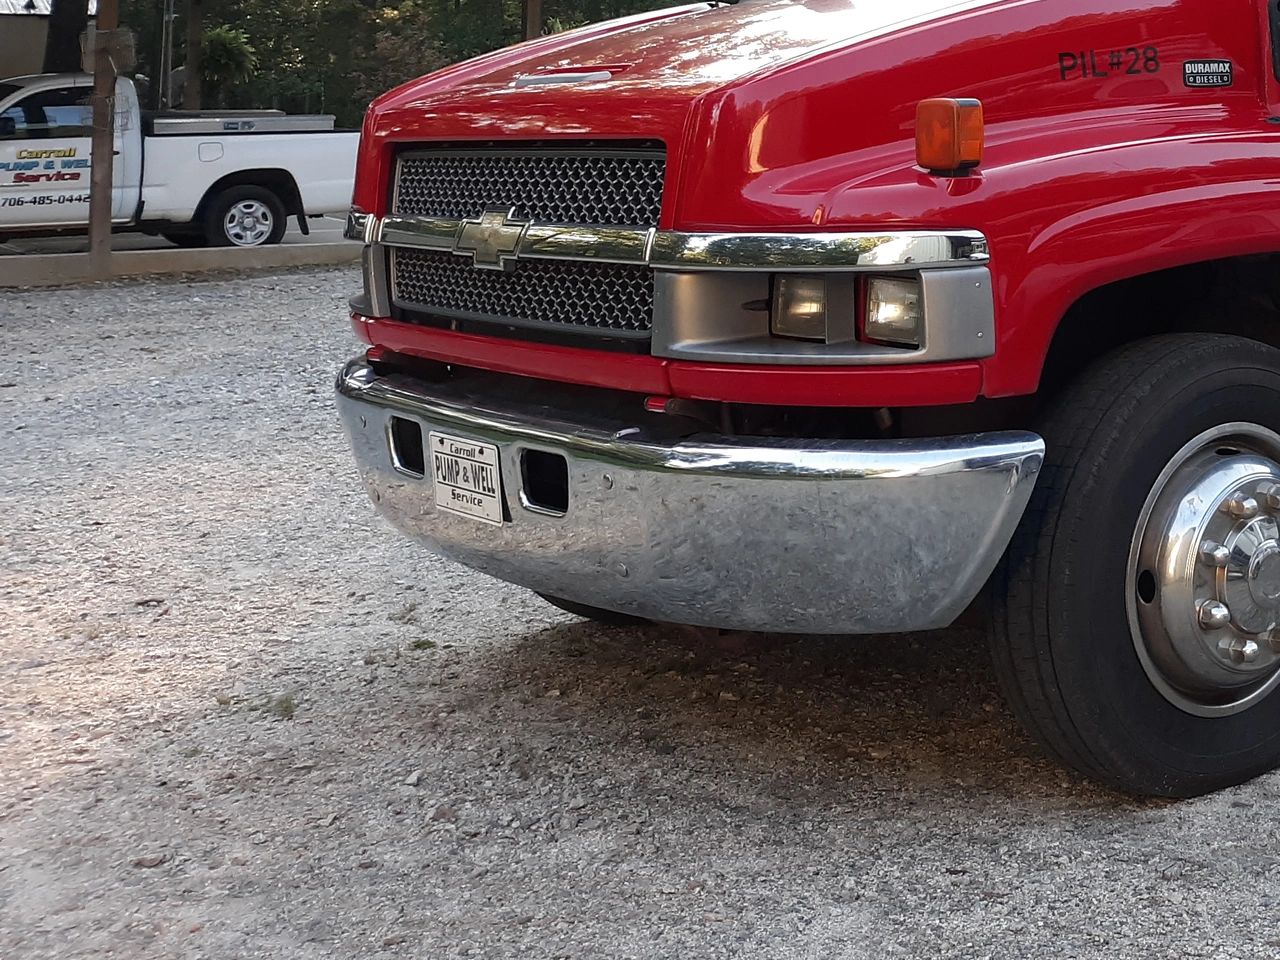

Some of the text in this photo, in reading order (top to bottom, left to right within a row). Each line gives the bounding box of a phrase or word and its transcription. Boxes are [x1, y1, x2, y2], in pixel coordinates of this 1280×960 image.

[1185, 62, 1230, 74] DURAMAX
[1195, 75, 1222, 84] DIESEL
[61, 159, 92, 169] WEL
[12, 171, 81, 183] Service
[1, 194, 91, 207] 706-485-0442
[450, 443, 476, 459] Carroll
[434, 454, 496, 494] PUMP & WELL
[451, 489, 483, 507] Service
